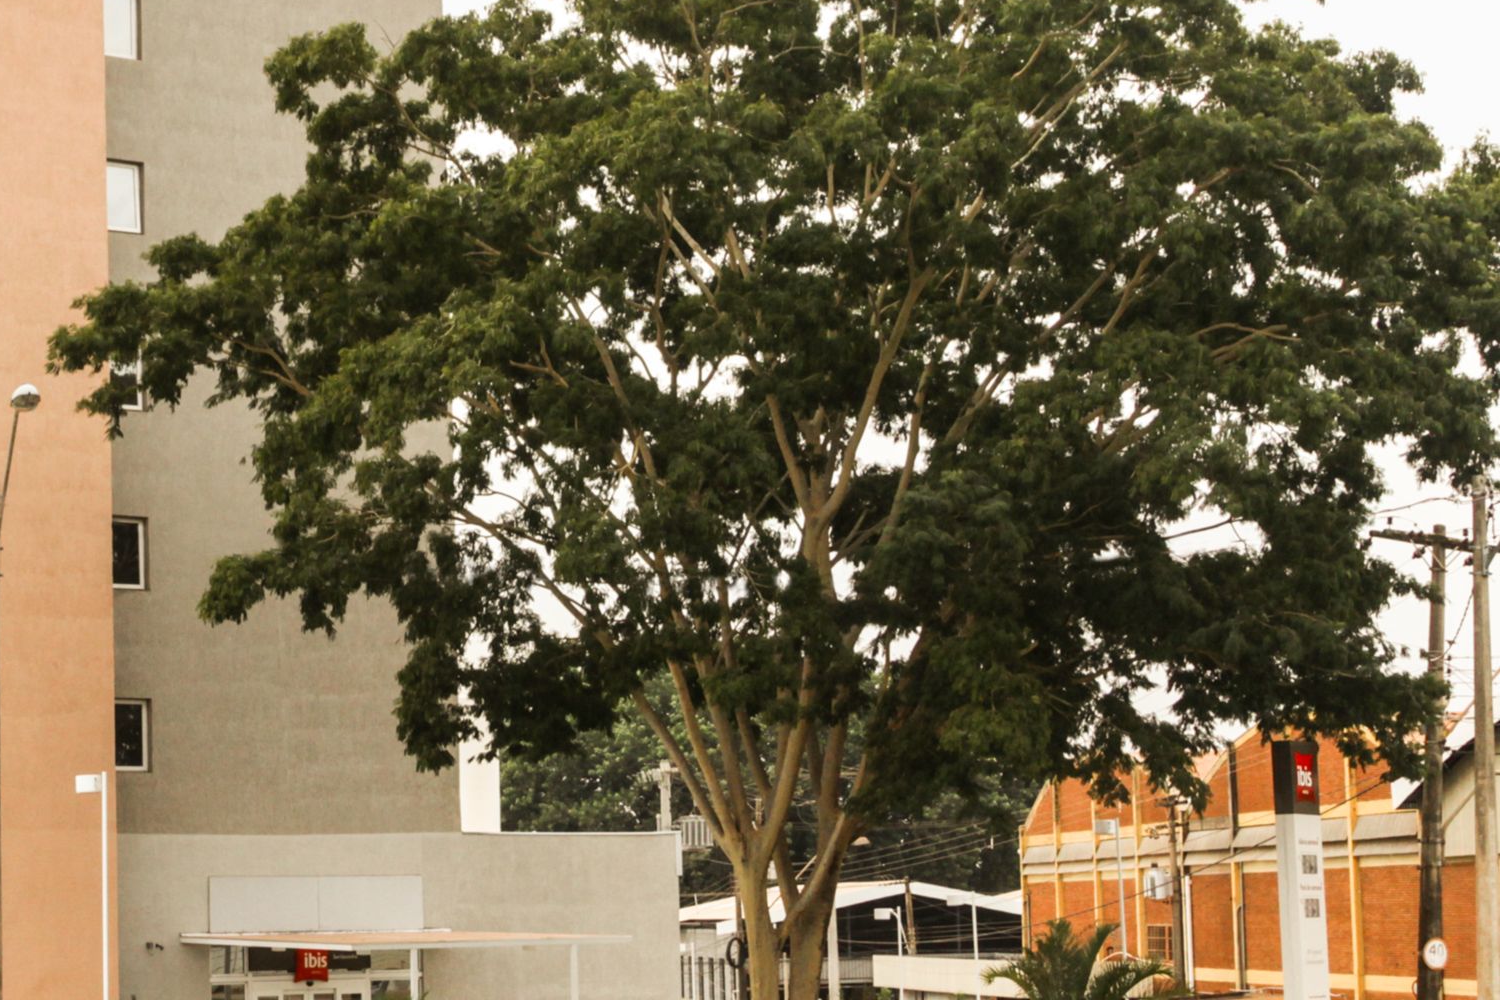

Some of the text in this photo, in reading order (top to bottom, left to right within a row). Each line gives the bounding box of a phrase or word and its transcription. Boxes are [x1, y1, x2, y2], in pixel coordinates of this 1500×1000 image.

[1296, 765, 1313, 787] ibis
[1428, 943, 1445, 957] 40
[304, 952, 328, 969] ibis
